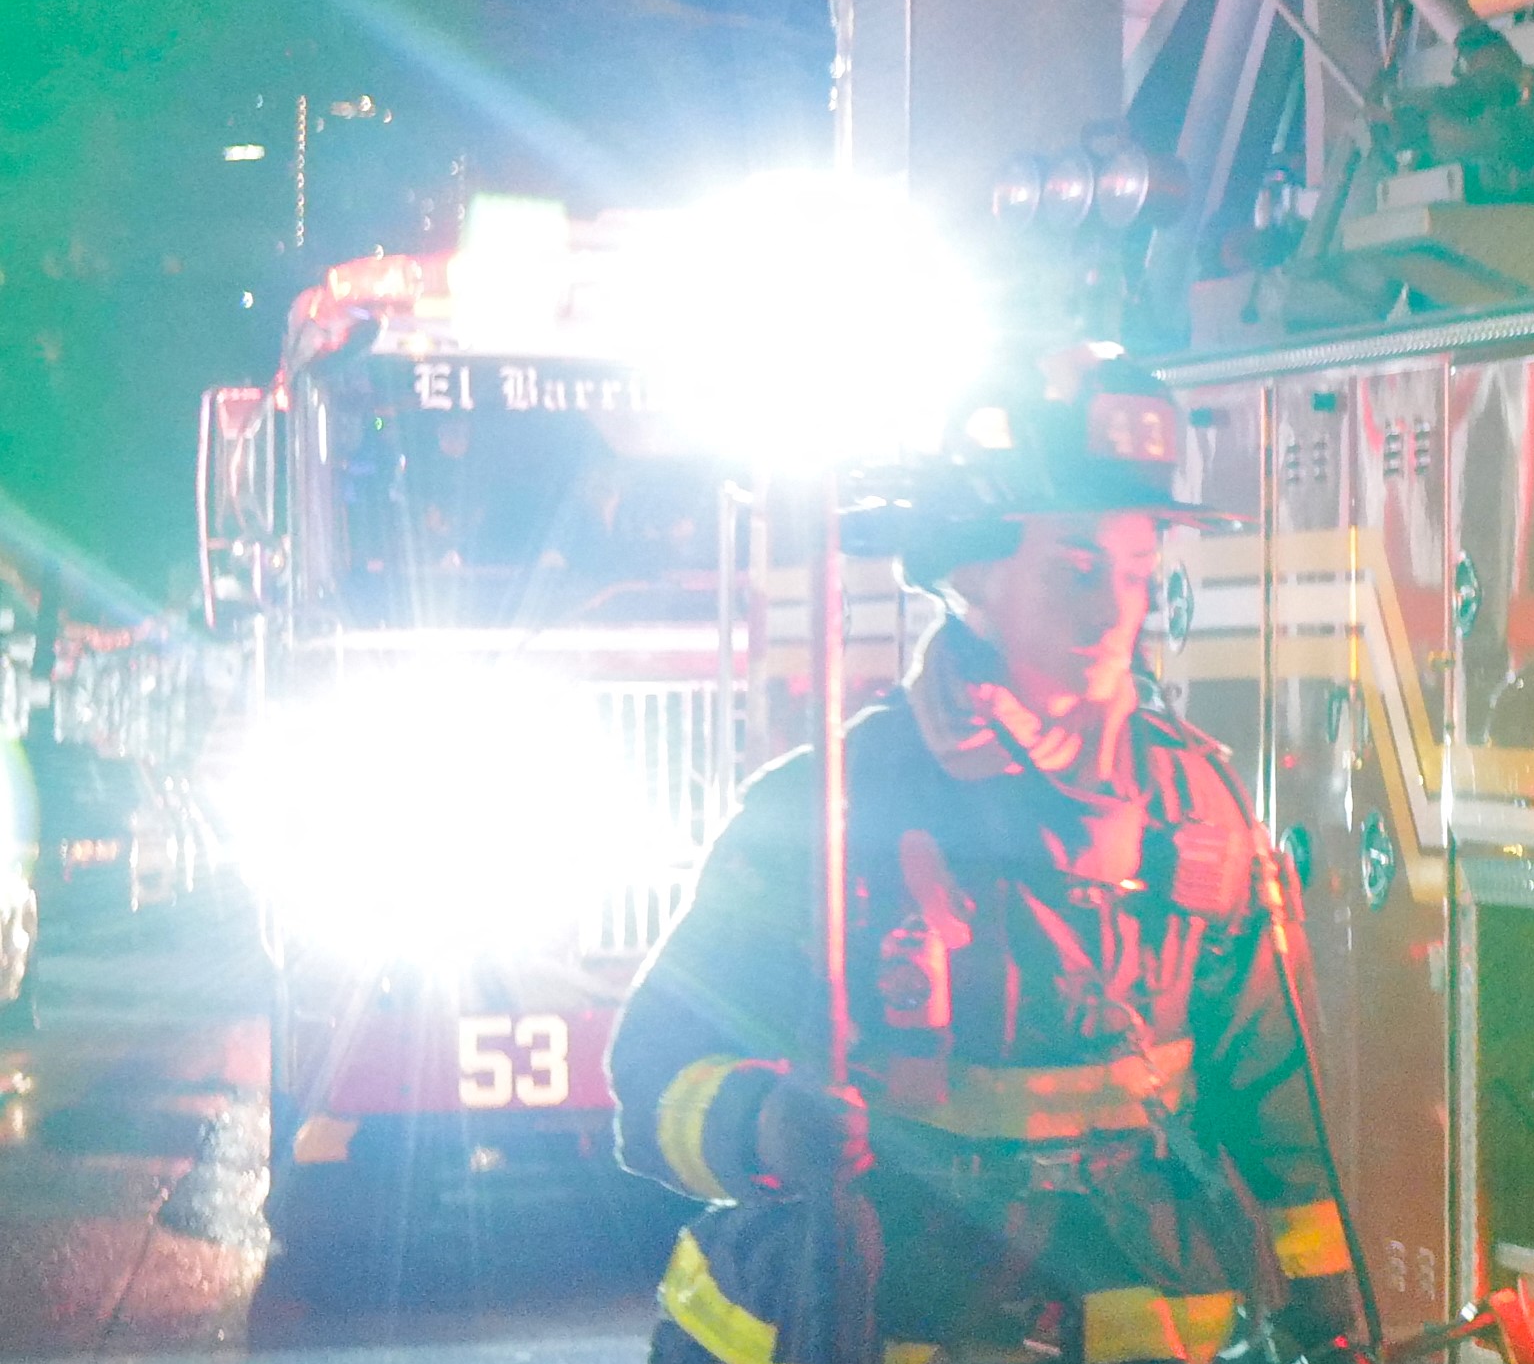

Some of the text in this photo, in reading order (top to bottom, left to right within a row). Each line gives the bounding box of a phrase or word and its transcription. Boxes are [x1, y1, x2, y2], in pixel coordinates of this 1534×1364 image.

[414, 362, 652, 412] El Barri
[459, 1015, 569, 1107] 53
